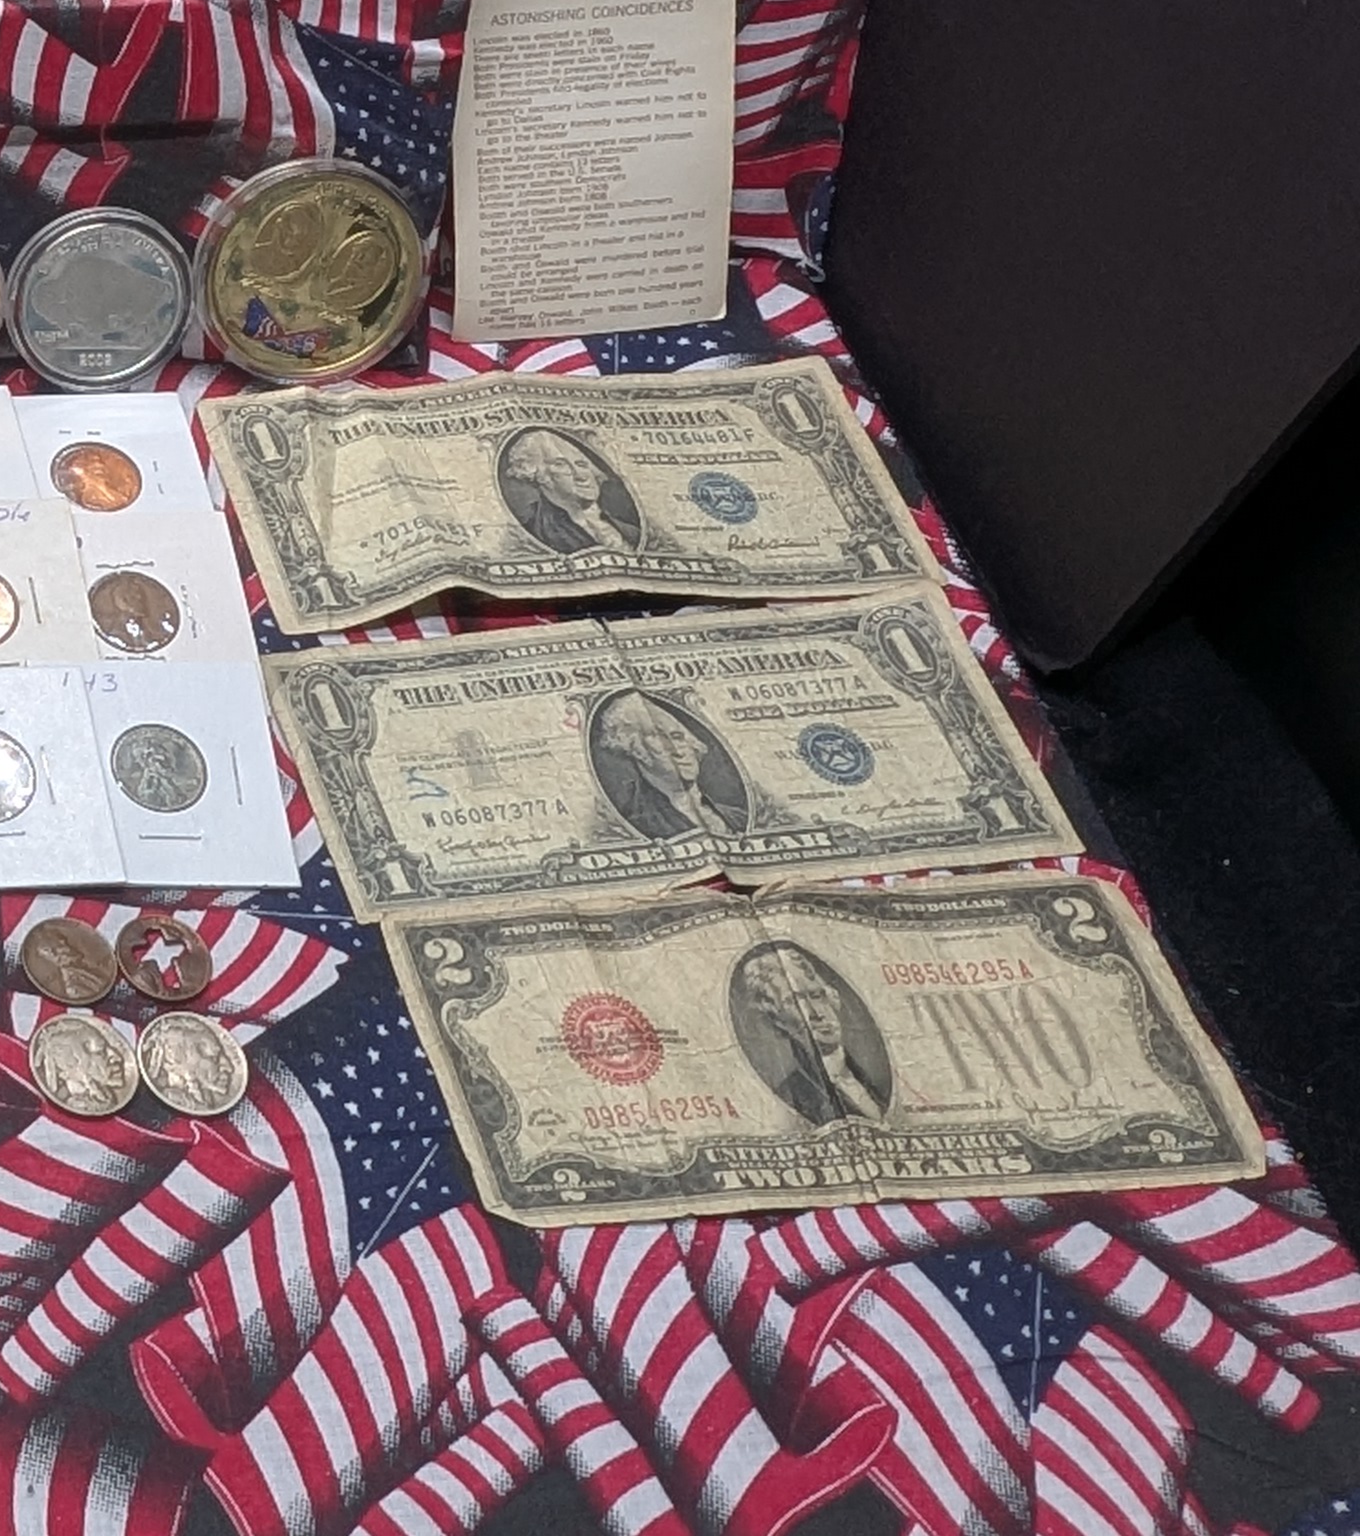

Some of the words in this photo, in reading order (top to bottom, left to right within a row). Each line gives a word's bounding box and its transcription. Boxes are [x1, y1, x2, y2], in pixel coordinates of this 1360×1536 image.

[490, 6, 587, 26] ASTONISHING
[329, 418, 383, 446] THE
[382, 412, 481, 439] UNITED
[613, 405, 733, 429] AMERICA
[488, 555, 569, 580] ONE
[393, 683, 458, 708] THE
[461, 672, 570, 700] UNITED
[676, 658, 705, 681] OF
[705, 646, 848, 677] AMERICA
[578, 846, 666, 871] ONE
[671, 831, 833, 860] DOLLAR
[890, 901, 927, 914] TWO
[927, 897, 1009, 913] DOLLARS
[1052, 895, 1108, 944] 2
[499, 925, 537, 938] TWO
[539, 920, 615, 936] DOLLARS
[422, 936, 474, 989] 2
[704, 1141, 799, 1164] UNITED
[908, 1132, 1024, 1149] AMERICA
[713, 1164, 821, 1190] TWO
[823, 1153, 1035, 1188] DOLLARS
